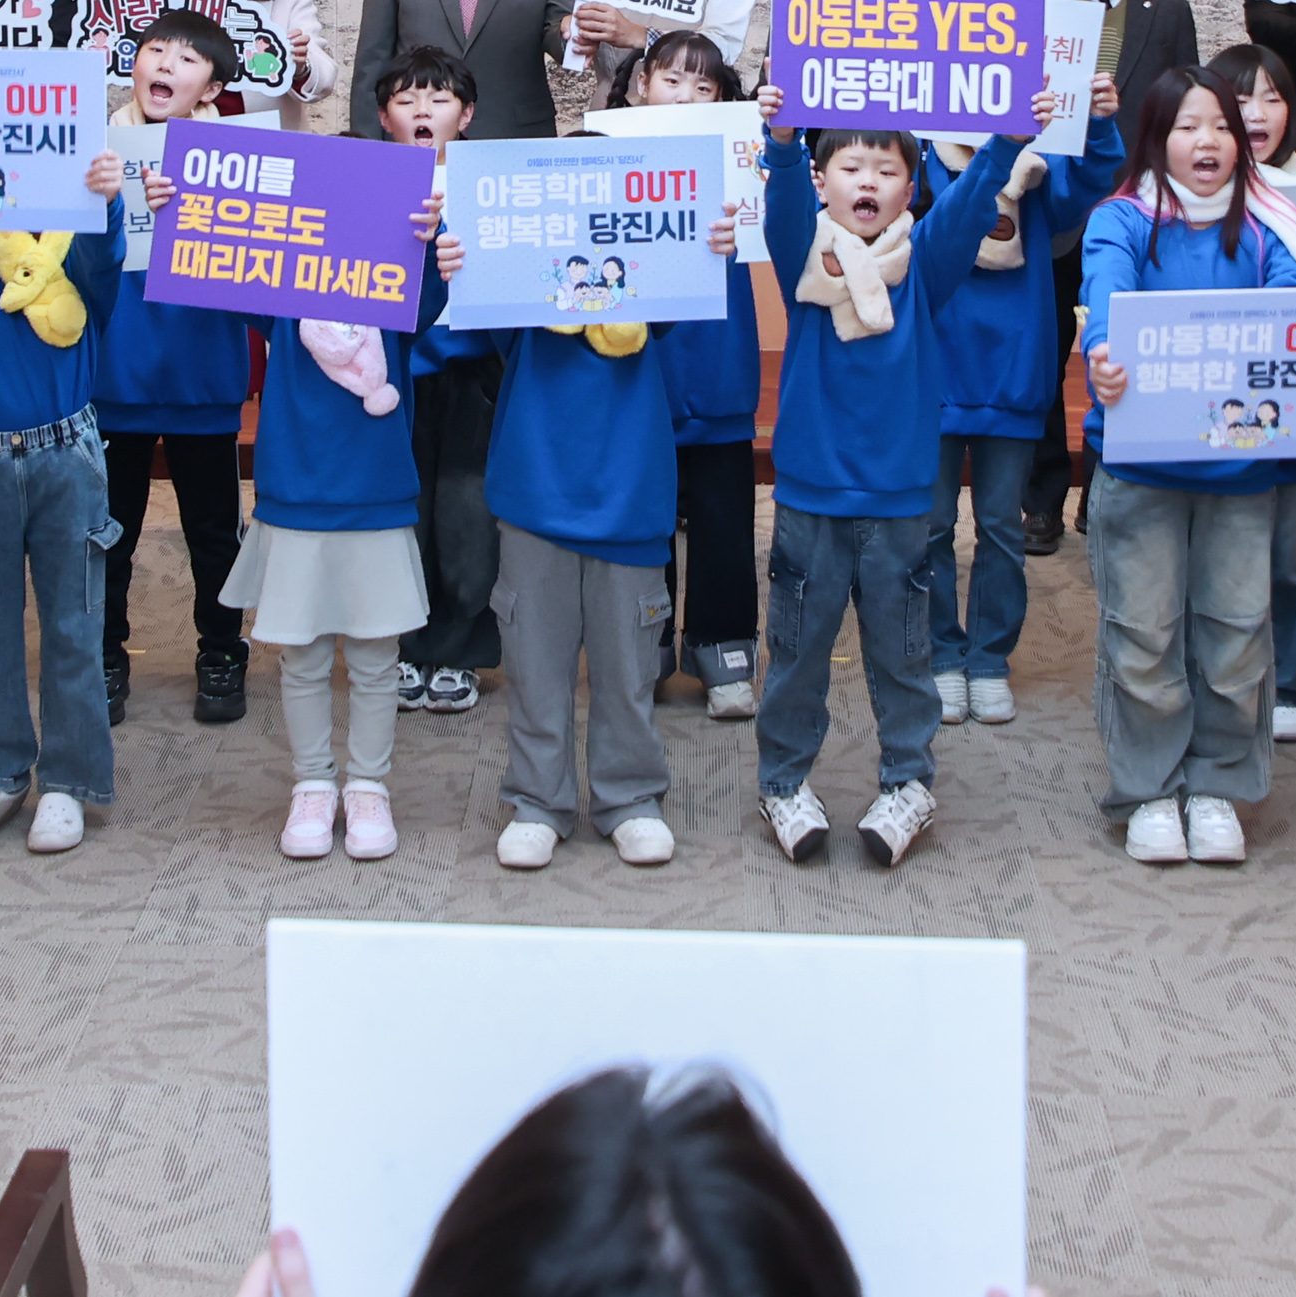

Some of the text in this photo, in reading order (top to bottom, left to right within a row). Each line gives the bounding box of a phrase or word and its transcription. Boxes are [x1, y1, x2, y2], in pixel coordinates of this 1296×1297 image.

[928, 0, 1028, 56] YES,
[6, 83, 77, 116] OUT!
[801, 58, 1012, 115] 아동학대 NO
[182, 147, 295, 197] 아이를
[476, 169, 697, 208] 아동학대 OUT!
[176, 192, 327, 246] 꽃으로도
[477, 213, 579, 249] 행복한
[589, 210, 696, 245] 당진시!
[170, 238, 407, 303] 때리지 마세요
[1137, 322, 1273, 356] 아동학대
[1136, 360, 1237, 394] 행복한
